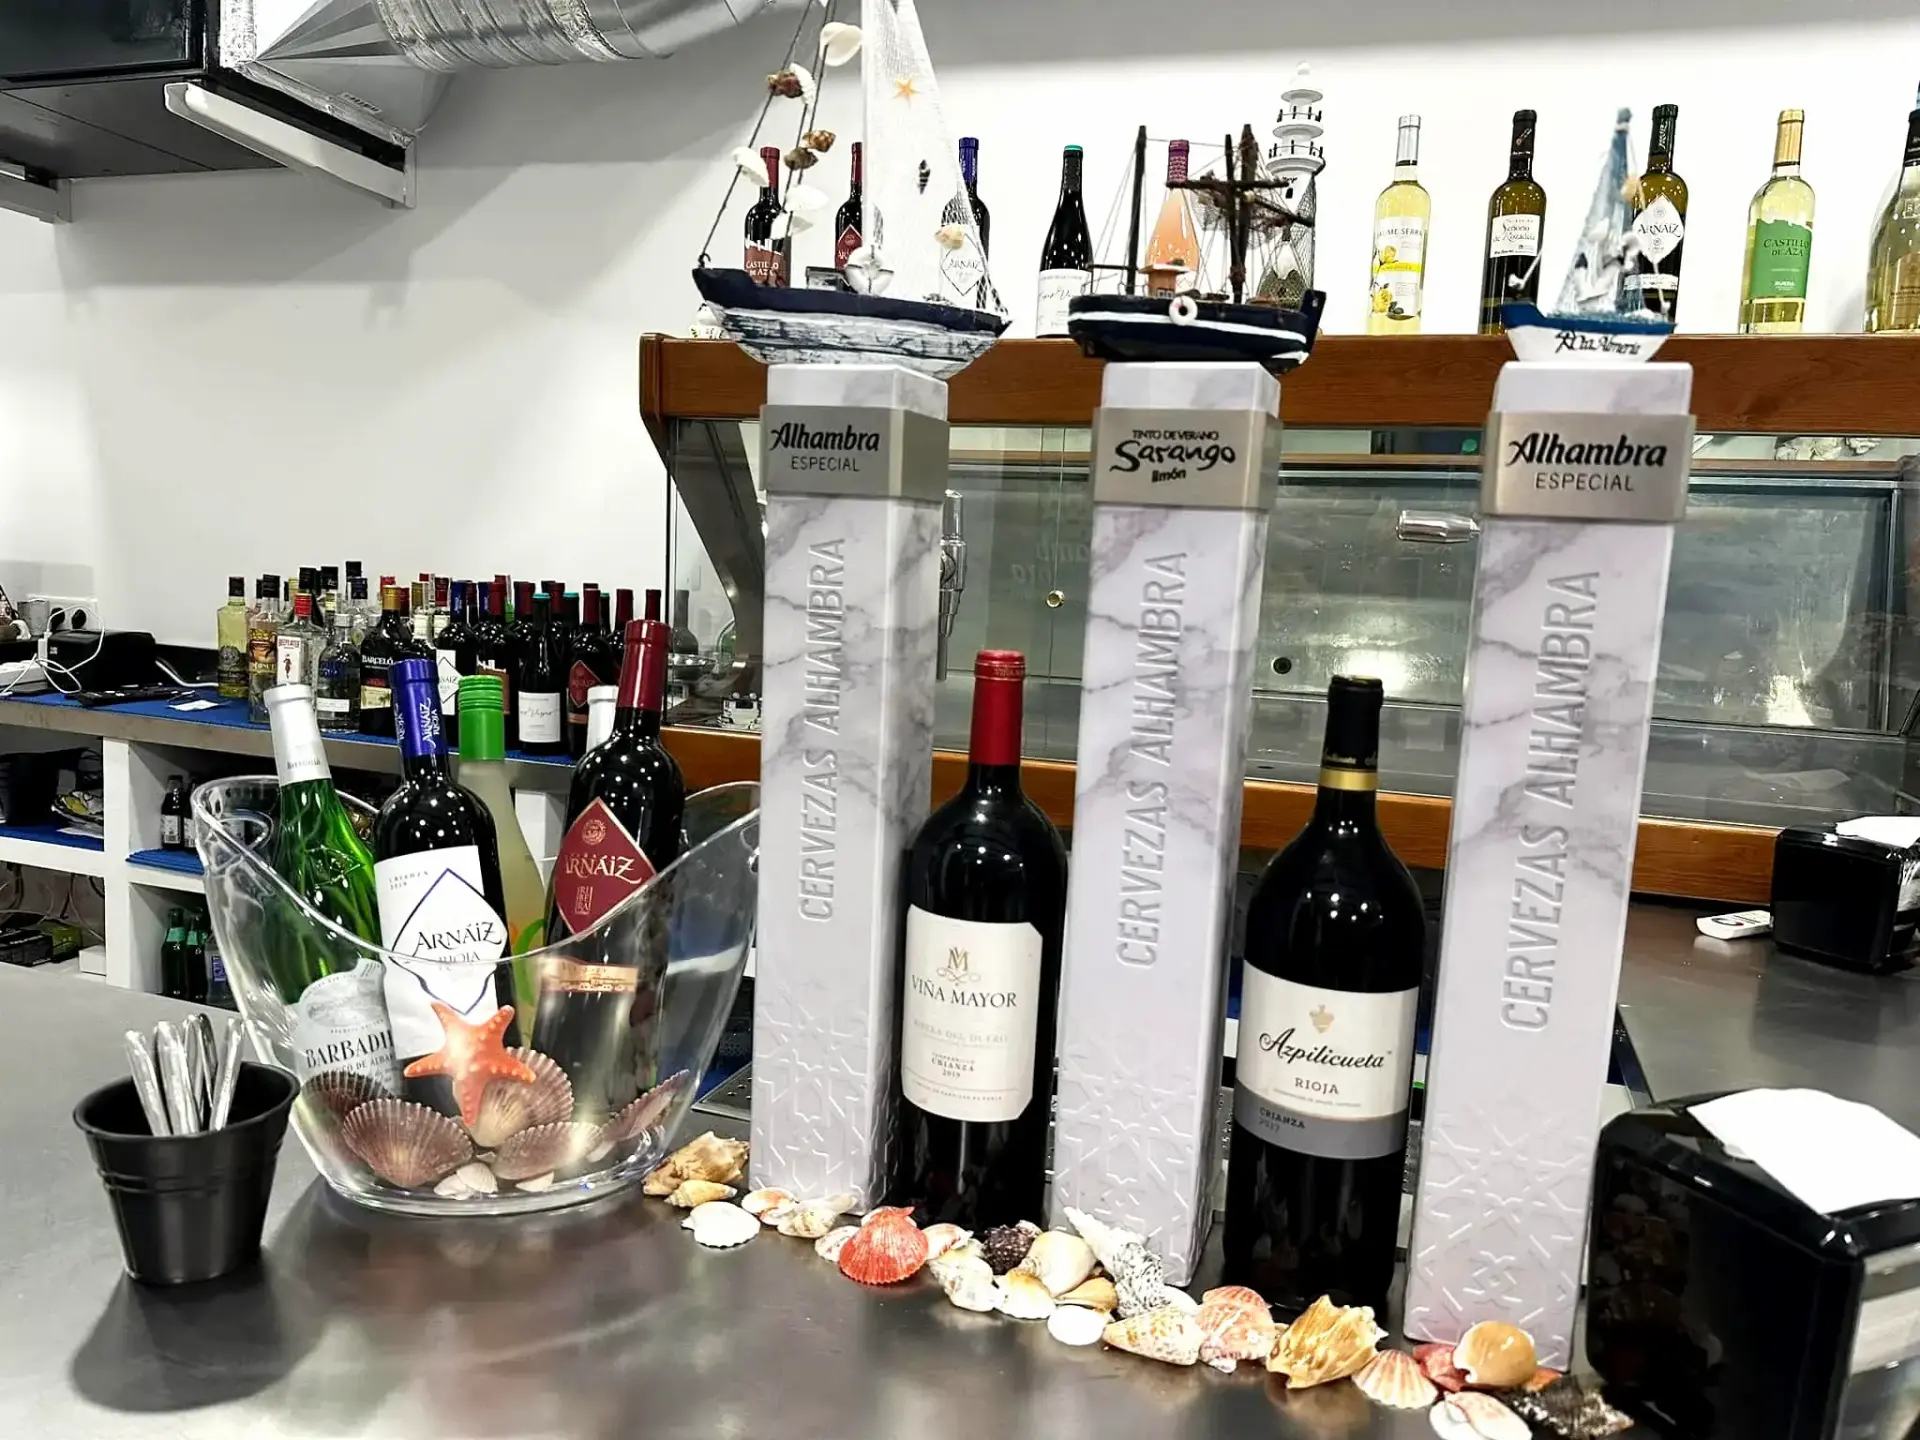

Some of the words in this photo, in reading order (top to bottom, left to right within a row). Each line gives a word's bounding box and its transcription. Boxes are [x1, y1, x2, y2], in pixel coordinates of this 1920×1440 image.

[770, 422, 880, 451] Alhambra
[1132, 429, 1162, 440] TINTO
[1163, 429, 1176, 440] DE
[1177, 430, 1219, 440] VERANO
[1505, 432, 1668, 467] Alhambra
[791, 455, 860, 472] ESPECIAL
[1109, 439, 1236, 472] Sarango
[1151, 466, 1186, 483] limón
[1534, 471, 1635, 492] ESPECIAL
[803, 537, 846, 736] ALHAMBRA
[1128, 551, 1188, 767] ALHAMBRA
[1523, 571, 1600, 810] ALHAMBRA
[798, 748, 838, 924] CERVEZAS
[1115, 780, 1169, 970] CERVEZAS
[1499, 824, 1570, 1032] CERVEZAS
[911, 974, 946, 1002] VIÑA
[951, 989, 1018, 1009] MAYOR
[931, 1057, 974, 1072] CRIANZA
[1259, 1027, 1384, 1068] Azpilicueta
[1294, 1077, 1340, 1096] RIOJA
[1259, 1107, 1306, 1129] CRIANZA
